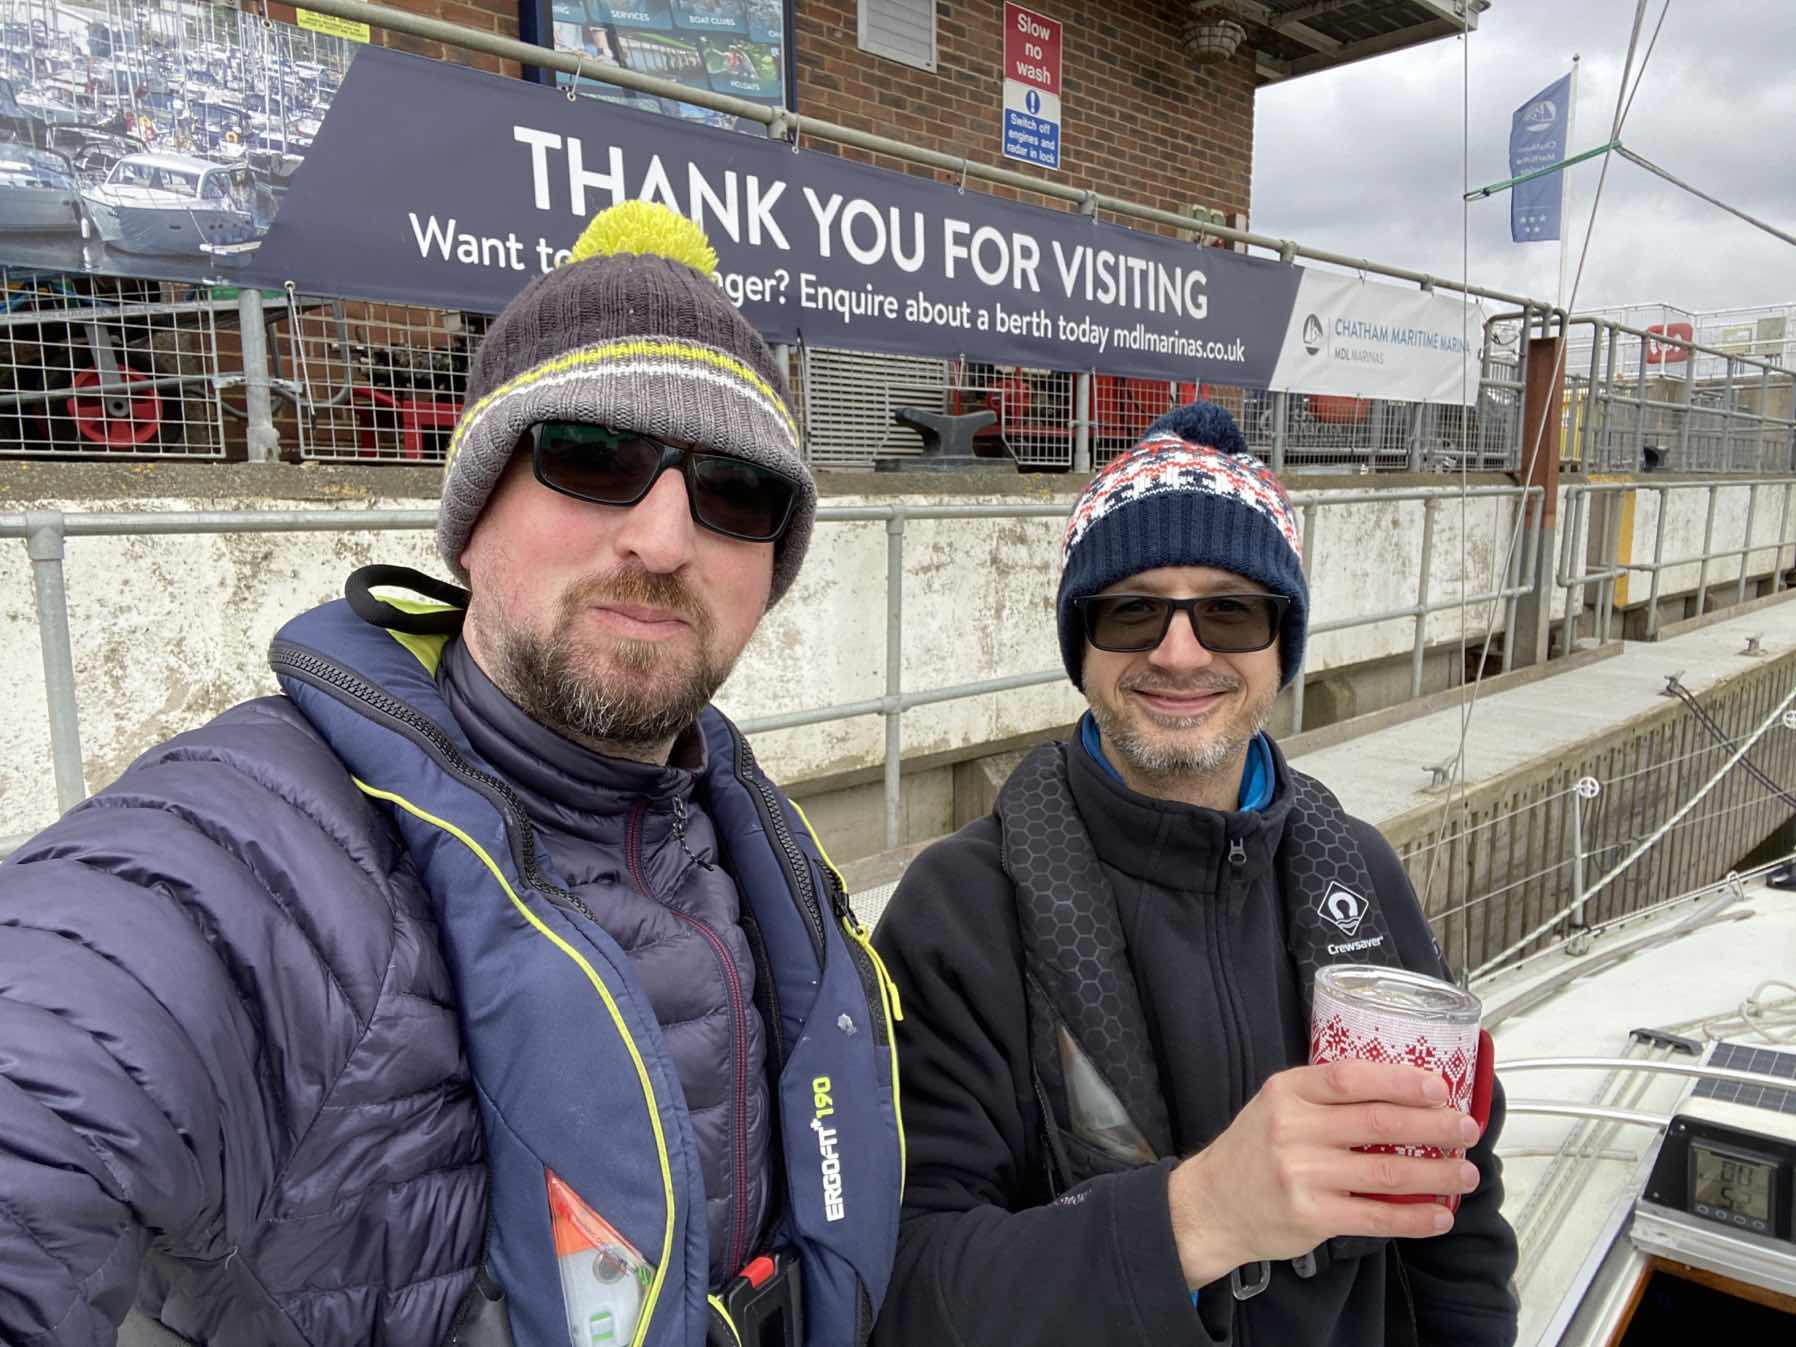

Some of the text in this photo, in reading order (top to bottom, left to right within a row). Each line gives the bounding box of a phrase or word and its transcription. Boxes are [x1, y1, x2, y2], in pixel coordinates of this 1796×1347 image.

[611, 9, 650, 22] SERVICES
[1017, 13, 1051, 41] Slow
[1025, 42, 1042, 60] no
[1016, 61, 1051, 85] wash
[1010, 113, 1051, 135] Switch off
[1008, 129, 1055, 150] engines and
[1006, 143, 1056, 164] radar in lock
[514, 126, 1208, 319] THANK YOU FOR VISITING
[408, 213, 525, 270] Want
[800, 273, 898, 323] Enquire
[905, 291, 971, 328] about
[977, 310, 989, 331] a
[996, 303, 1052, 338] berth
[1058, 316, 1109, 352] today
[1113, 324, 1245, 362] mdlmarinas.co.uk
[1335, 318, 1388, 342] CHATHAM
[1390, 325, 1439, 350] MARITIME
[1335, 347, 1384, 365] MDL MARINAS
[1327, 936, 1384, 955] Crewsaver
[812, 1076, 834, 1119] 190
